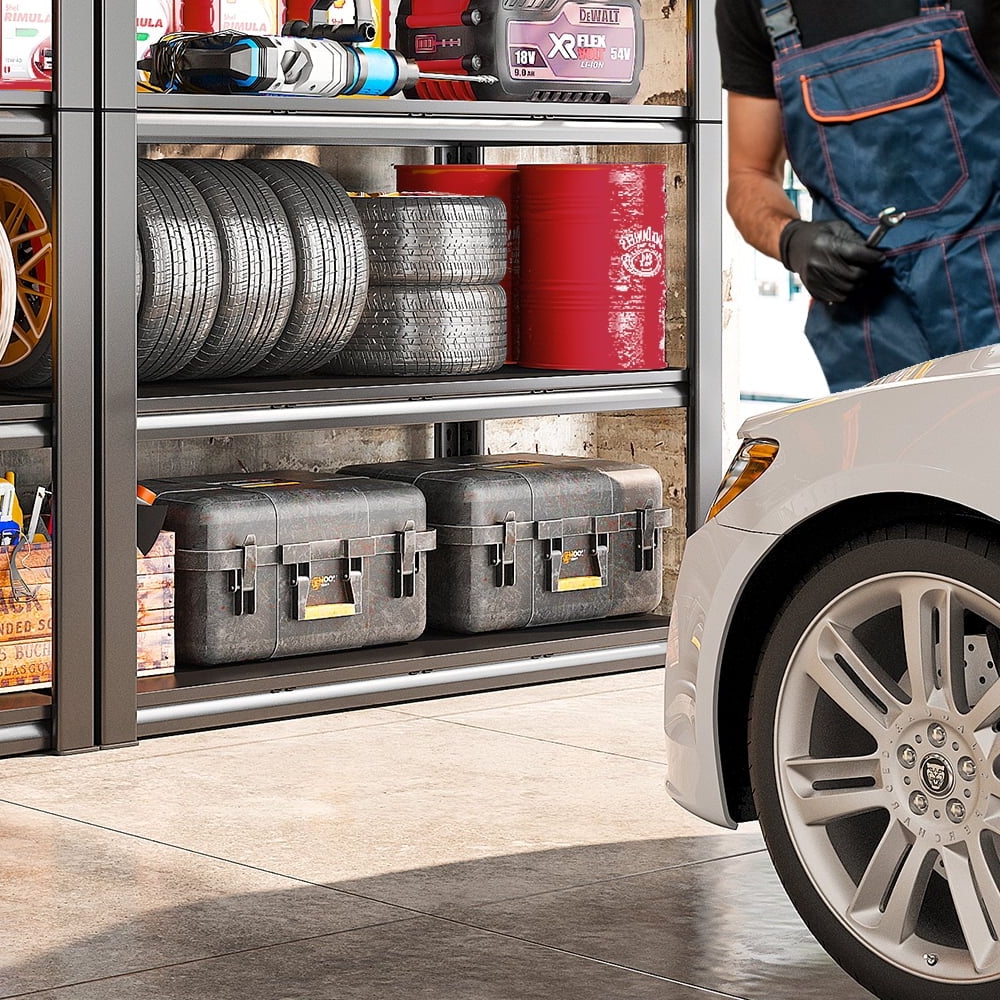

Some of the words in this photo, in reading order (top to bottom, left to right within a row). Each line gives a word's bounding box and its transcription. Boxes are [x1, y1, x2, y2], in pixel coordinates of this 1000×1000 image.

[137, 18, 163, 28] ULA
[223, 21, 267, 32] RIMULA
[577, 34, 606, 47] FLEX
[514, 50, 536, 65] 18V
[610, 47, 631, 61] 54V
